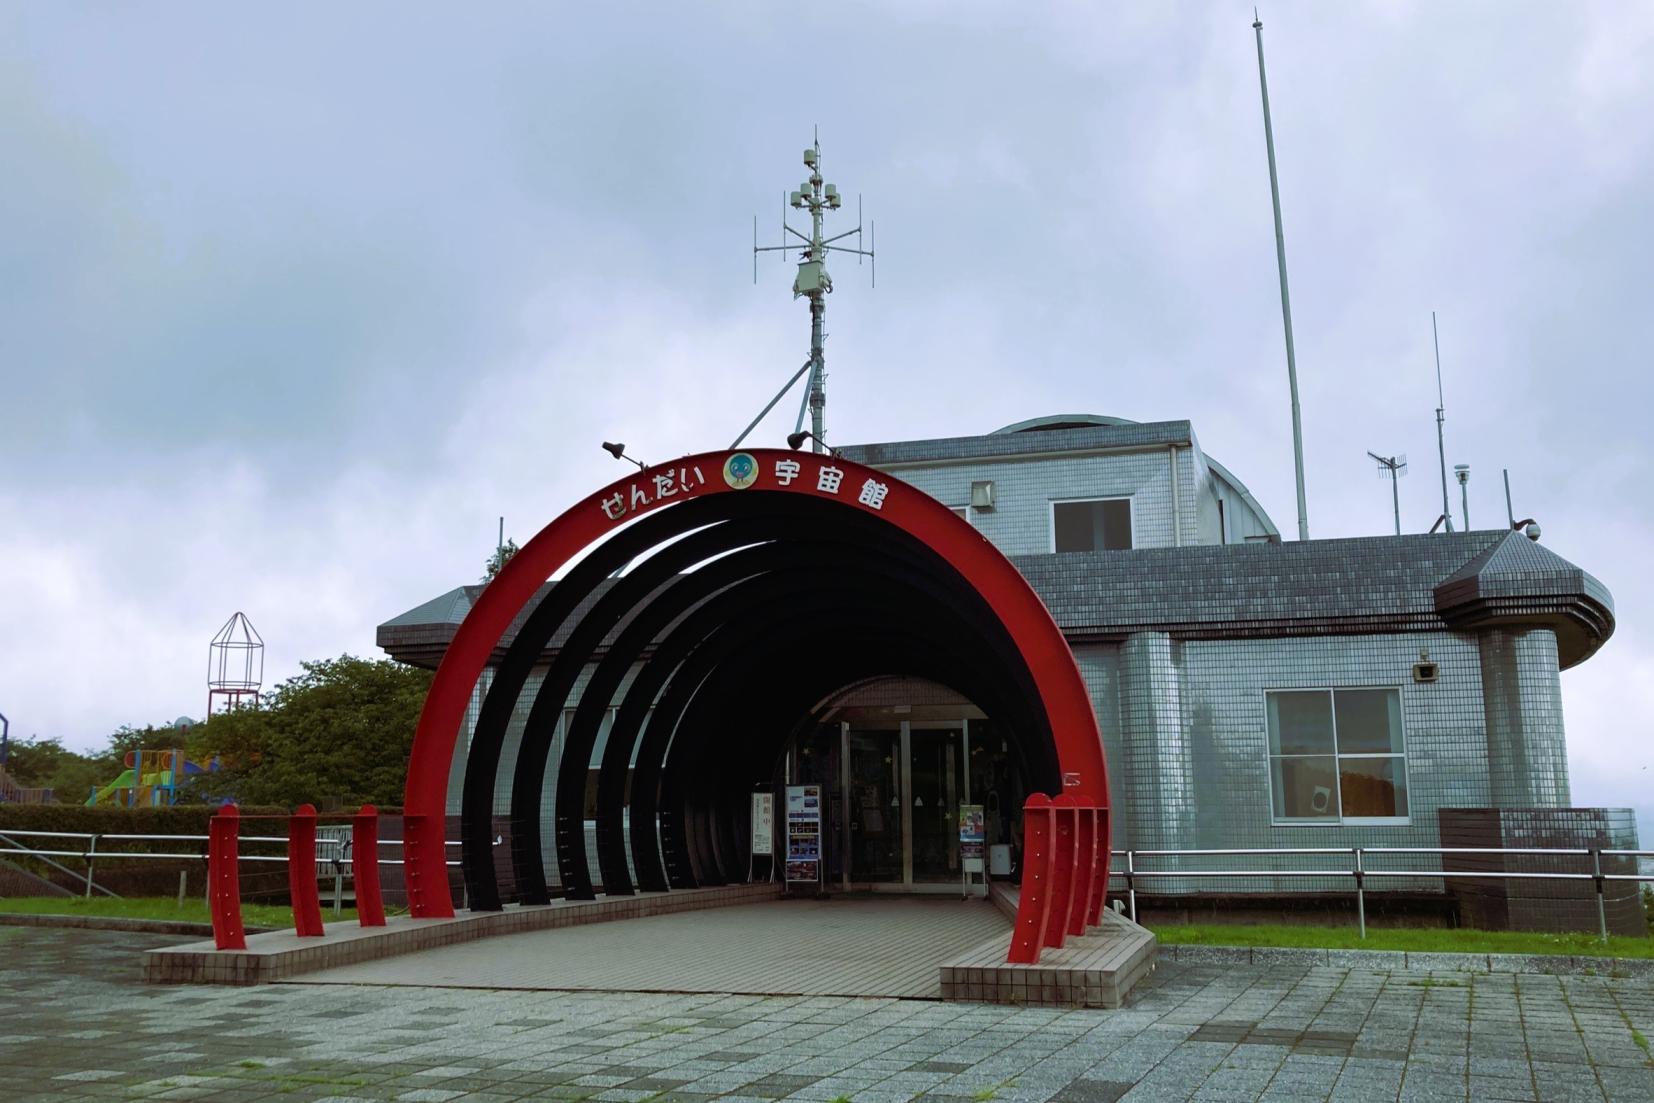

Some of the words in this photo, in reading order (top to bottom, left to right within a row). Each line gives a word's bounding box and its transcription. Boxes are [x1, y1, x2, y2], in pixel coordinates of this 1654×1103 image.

[601, 466, 705, 520] せんだい
[775, 459, 889, 510] 宇宙館
